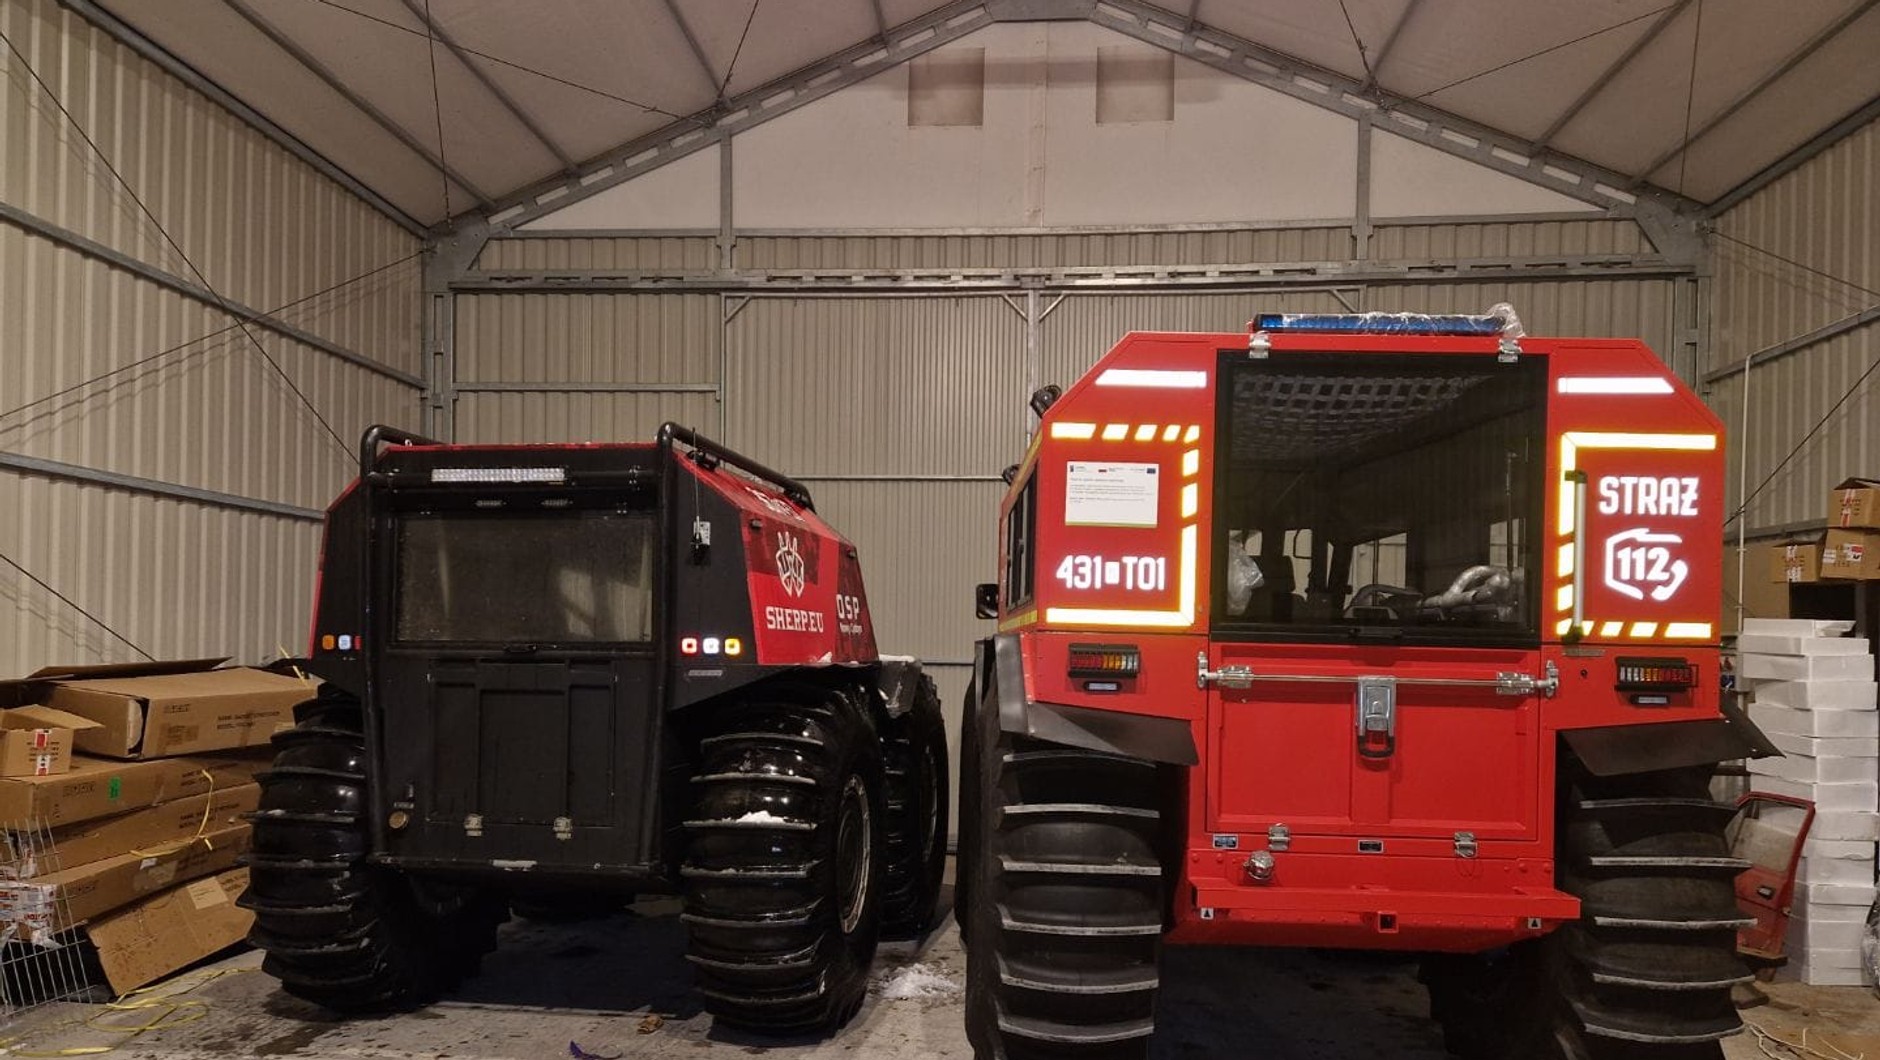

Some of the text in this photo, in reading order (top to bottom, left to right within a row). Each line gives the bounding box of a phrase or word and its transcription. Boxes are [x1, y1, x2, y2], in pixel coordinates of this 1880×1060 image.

[1055, 554, 1102, 590] 431
[1617, 546, 1671, 581] 112
[765, 605, 824, 633] SHERP.EU
[836, 594, 860, 620] OSP
